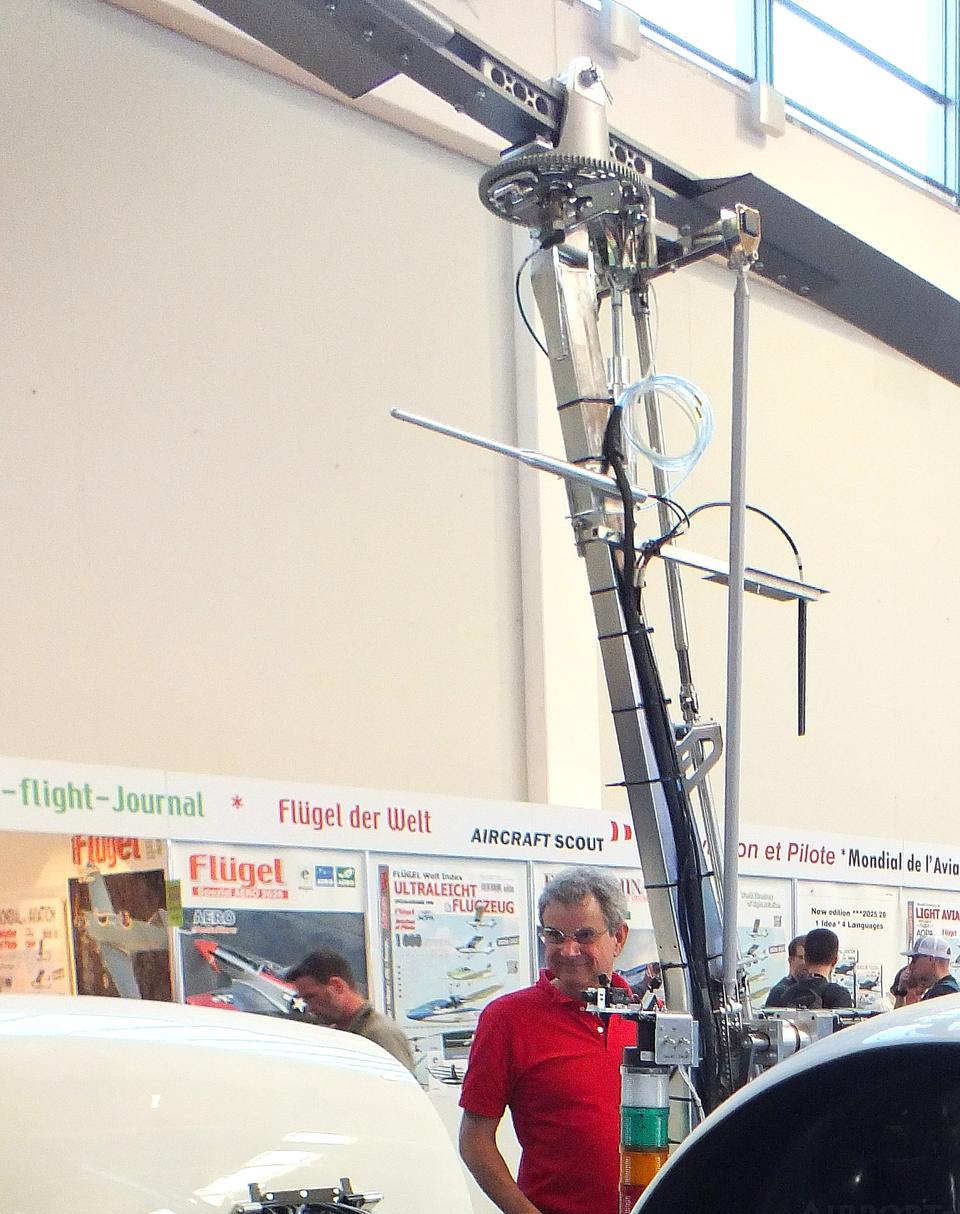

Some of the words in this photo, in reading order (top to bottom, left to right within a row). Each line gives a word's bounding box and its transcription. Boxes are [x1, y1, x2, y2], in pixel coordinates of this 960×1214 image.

[279, 799, 342, 830] Flügel
[350, 805, 380, 829] der
[387, 808, 431, 833] Welt
[471, 828, 551, 848] AIRCRAFT
[554, 834, 604, 851] SCOUT
[765, 842, 781, 861] et
[787, 842, 835, 865] Pilote
[848, 849, 902, 870] Mondial
[907, 854, 921, 872] de
[189, 854, 285, 887] Flügel
[394, 881, 478, 898] ULTRALEICHT
[916, 907, 940, 920] LIGHT
[848, 921, 884, 931] Languages
